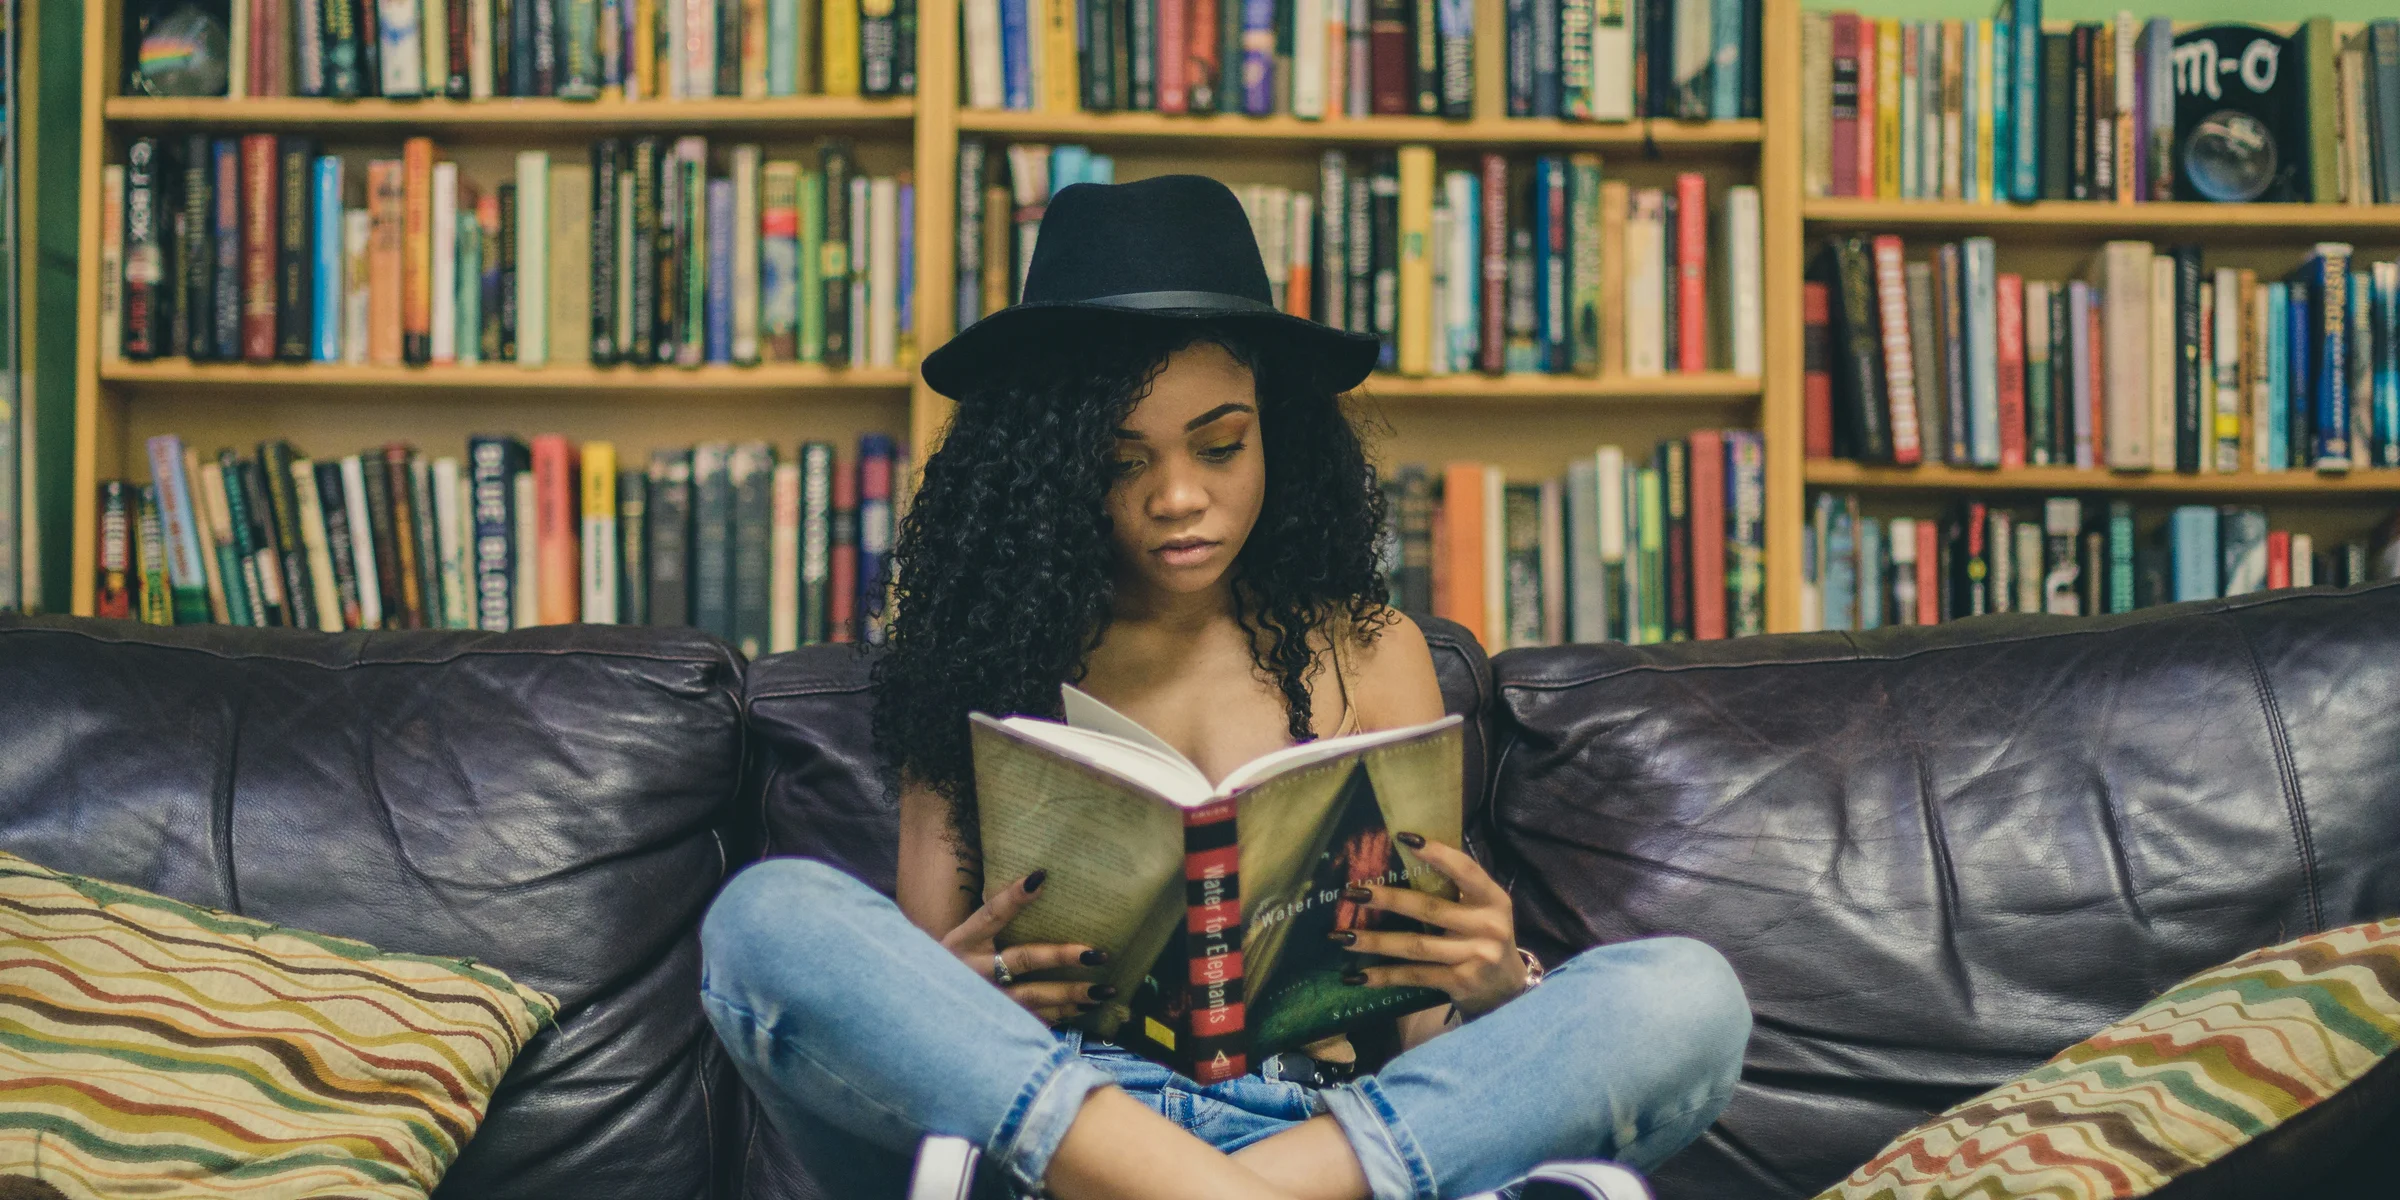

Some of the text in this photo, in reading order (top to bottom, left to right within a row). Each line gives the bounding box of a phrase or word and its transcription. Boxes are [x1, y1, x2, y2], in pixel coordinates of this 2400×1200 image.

[475, 442, 506, 525] BLUE
[1261, 897, 1313, 928] Water
[1319, 888, 1340, 904] for
[1203, 863, 1230, 1024] Water for Elephants
[1332, 989, 1427, 1021] SARA GRUE
